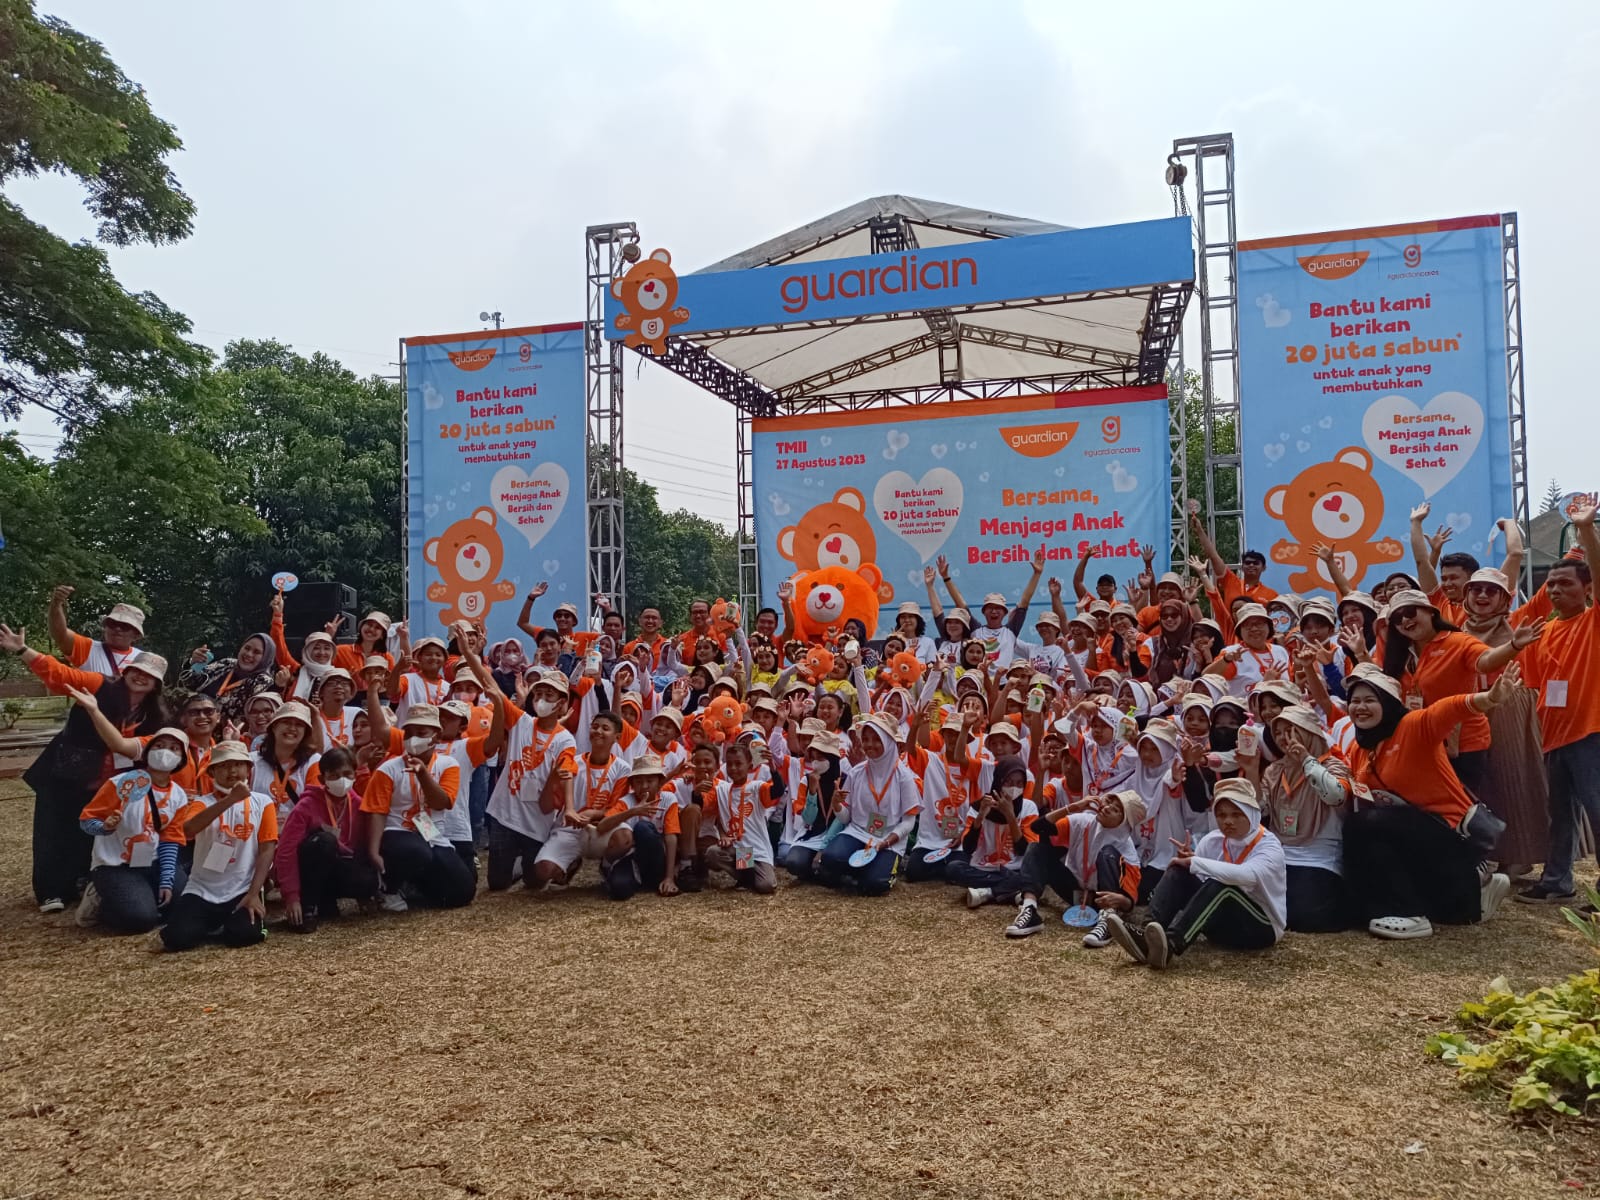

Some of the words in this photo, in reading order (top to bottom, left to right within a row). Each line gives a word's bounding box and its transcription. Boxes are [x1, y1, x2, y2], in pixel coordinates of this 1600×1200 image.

[1309, 257, 1360, 272] guardian
[781, 255, 977, 313] guardian
[1310, 299, 1374, 318] Bantu
[1380, 294, 1431, 312] kami
[1331, 318, 1410, 337] berikan
[455, 354, 490, 366] guardian
[1286, 345, 1317, 363] 20
[1322, 343, 1376, 365] juta
[1313, 368, 1354, 380] untuk
[1358, 365, 1392, 376] anak
[1396, 364, 1431, 376] yang
[456, 387, 499, 403] Bantu
[504, 383, 537, 398] kami
[1323, 379, 1423, 394] membutuhkan
[470, 404, 523, 418] berikan
[1393, 414, 1455, 425] Bersama,
[440, 423, 461, 438] 20
[465, 422, 500, 441] juta
[1012, 430, 1068, 447] guardian
[1379, 429, 1434, 441] Menjaga
[1438, 426, 1471, 437] Anak
[459, 442, 486, 453] untuk
[488, 441, 510, 450] anak
[513, 440, 536, 449] yang
[776, 441, 807, 454] TMII
[1390, 443, 1430, 455] Bersih
[1433, 442, 1458, 452] dan
[465, 452, 530, 463] membutuhkan
[776, 459, 788, 469] 27
[791, 457, 836, 471] Agustus
[839, 454, 865, 466] 2023
[1406, 457, 1446, 469] Sehat
[511, 480, 550, 489] Bersama,
[501, 493, 537, 502] Menjaga
[539, 490, 561, 499] Anak
[895, 490, 921, 498] Bantu
[923, 488, 943, 496] kami
[1002, 488, 1099, 506] Bersama,
[508, 504, 534, 513] Bersih
[904, 499, 935, 507] berikan
[518, 516, 544, 524] Sehat
[883, 510, 897, 520] 20
[899, 509, 923, 521] juta
[980, 516, 1067, 538] Menjaga
[1072, 511, 1125, 530] Anak
[968, 544, 1029, 564] Bersih
